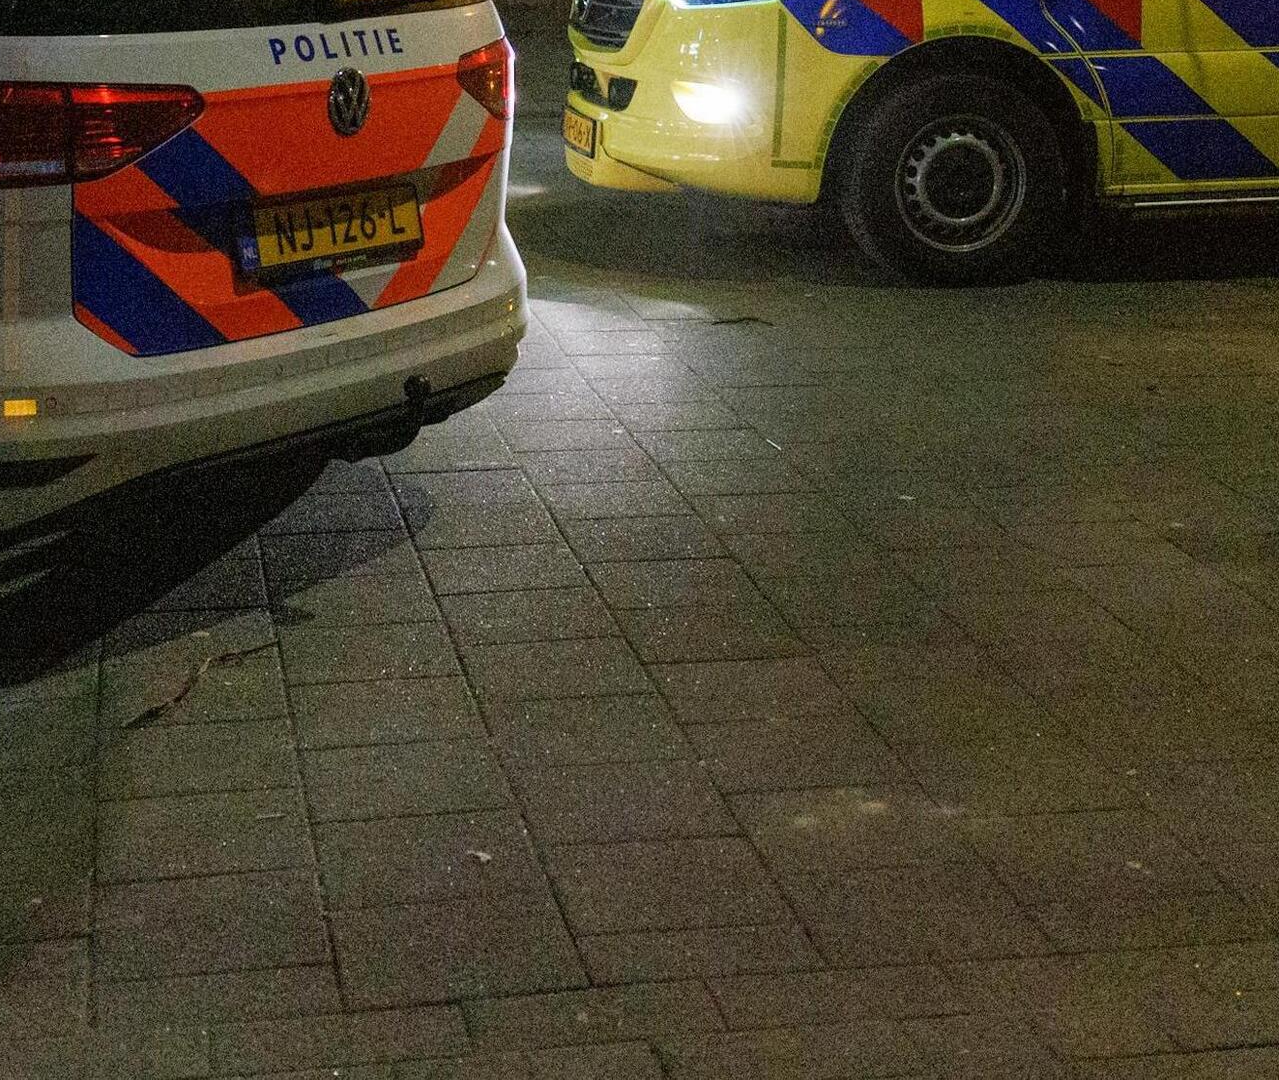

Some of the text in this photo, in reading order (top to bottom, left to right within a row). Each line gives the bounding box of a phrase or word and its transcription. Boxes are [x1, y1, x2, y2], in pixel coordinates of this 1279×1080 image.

[268, 28, 404, 65] POLITIE
[274, 199, 406, 255] NJ-126-L
[243, 247, 258, 261] NL
